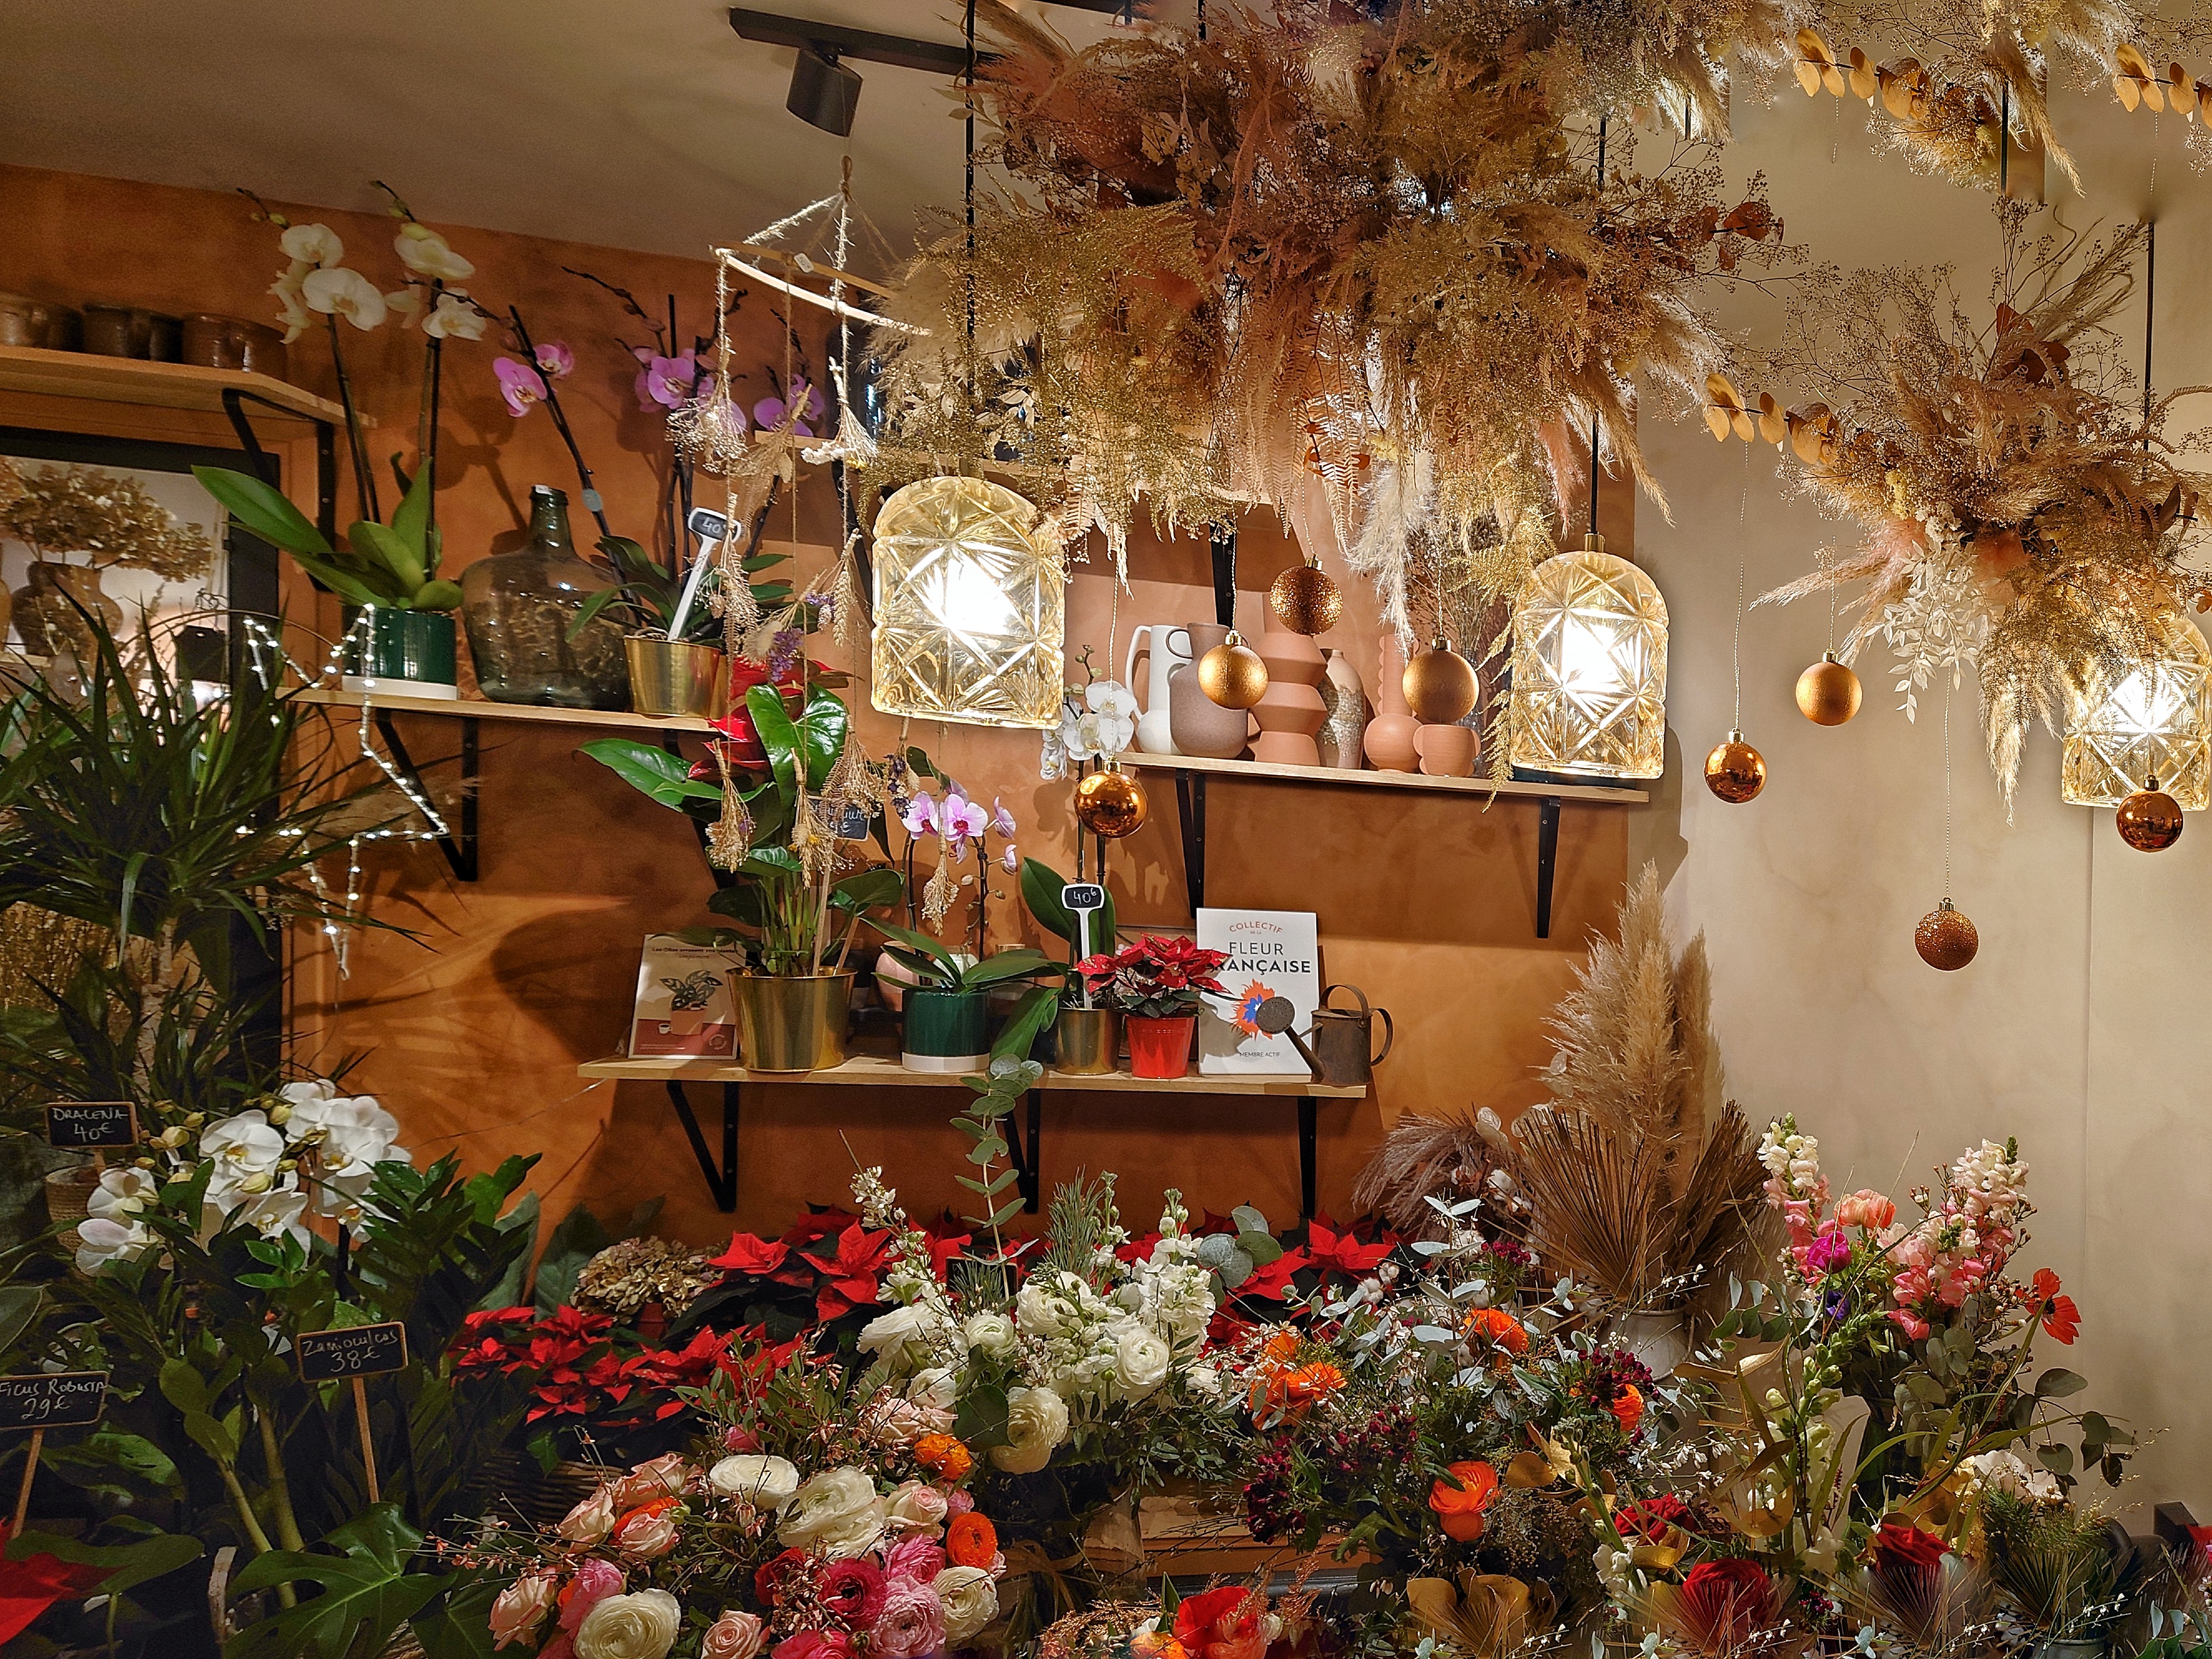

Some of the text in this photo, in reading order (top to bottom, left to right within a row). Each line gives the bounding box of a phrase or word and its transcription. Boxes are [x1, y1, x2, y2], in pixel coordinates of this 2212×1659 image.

[703, 517, 727, 534] 40
[1229, 921, 1283, 933] COLLECTIF
[1229, 942, 1284, 956] FLEUR
[1214, 959, 1311, 975] RANÇAISE
[74, 1122, 115, 1143] 40€
[330, 1346, 381, 1372] 38€
[20, 1395, 70, 1420] 29€
